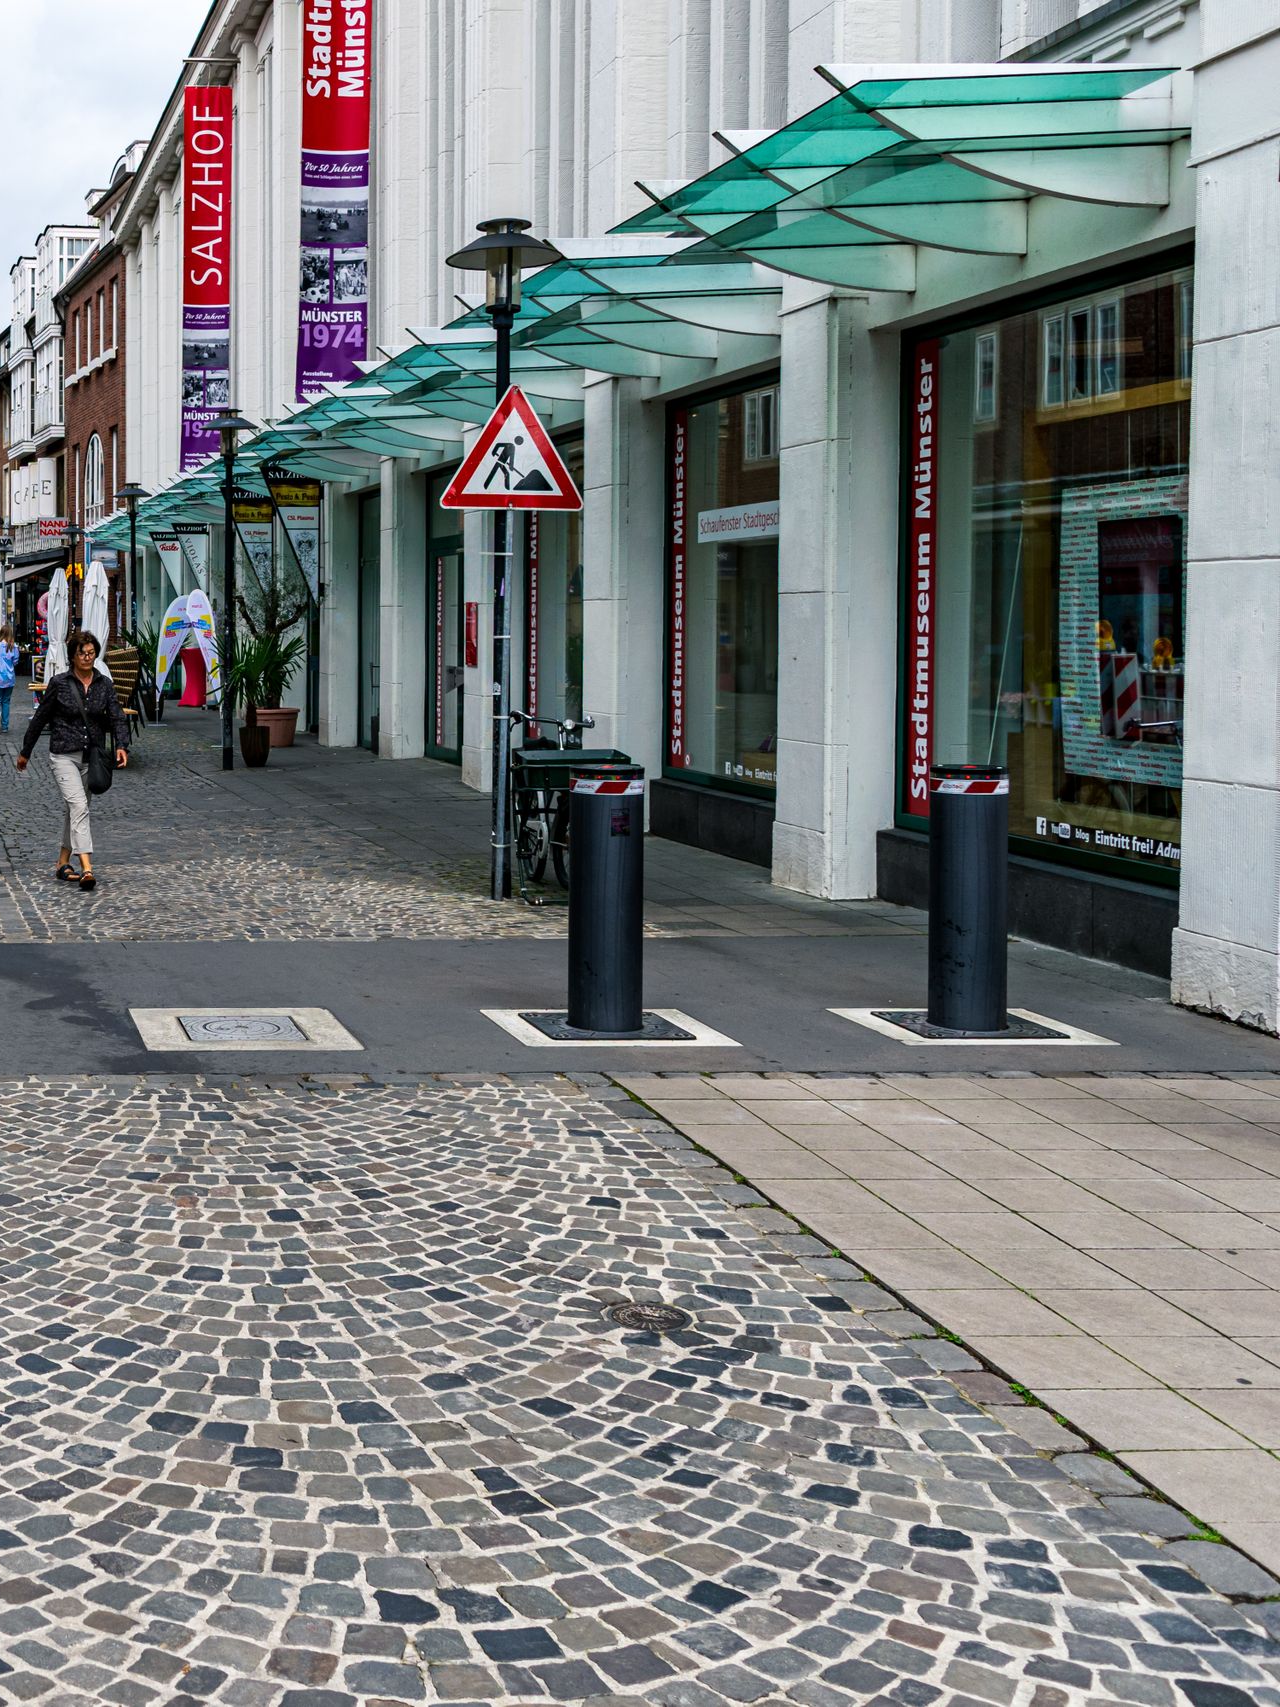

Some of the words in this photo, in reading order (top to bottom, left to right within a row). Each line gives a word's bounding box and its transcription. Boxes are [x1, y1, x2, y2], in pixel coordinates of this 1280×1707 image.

[306, 0, 332, 98] Stadt
[336, 0, 367, 97] Münst
[304, 162, 318, 171] Vor
[319, 164, 329, 172] 50
[330, 163, 364, 174] Jahren
[191, 105, 224, 286] SALZHOF
[202, 313, 226, 321] Jahren
[301, 307, 362, 322] MÜNSTER
[301, 323, 364, 348] 1974
[184, 410, 220, 421] MÜNSTE
[183, 421, 221, 438] 197
[914, 358, 934, 518] Münster
[268, 471, 306, 479] SALZHO
[673, 423, 684, 544] Münster
[40, 520, 69, 528] NANU
[700, 513, 742, 535] Schaufenster
[672, 555, 683, 755] Stadtmuseum
[910, 533, 931, 800] Stadtmuseum
[1075, 828, 1090, 842] blog
[1095, 829, 1130, 850] Eintritt
[1132, 836, 1154, 854] frei!
[1156, 842, 1180, 859] Adm
